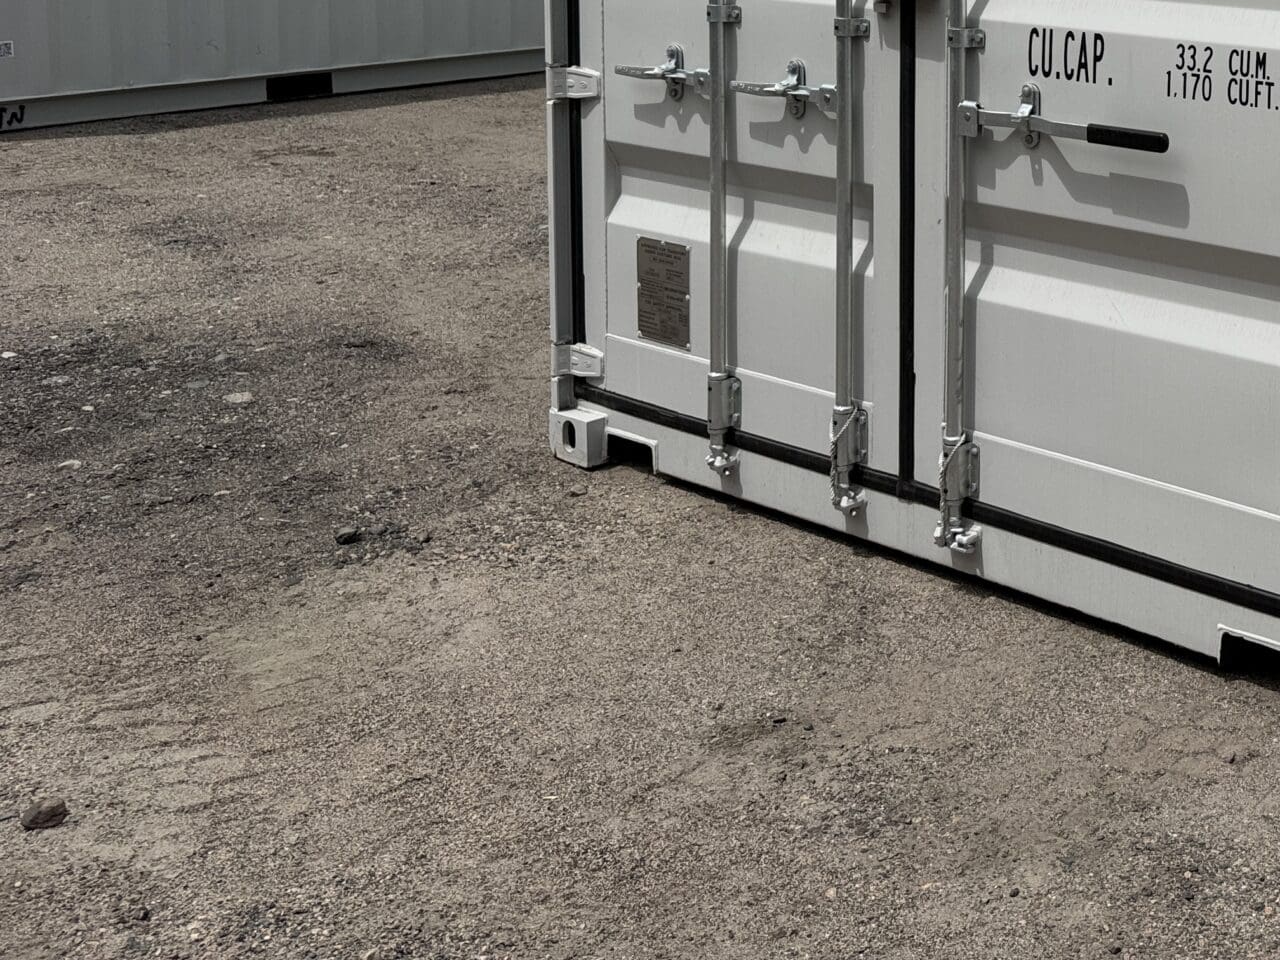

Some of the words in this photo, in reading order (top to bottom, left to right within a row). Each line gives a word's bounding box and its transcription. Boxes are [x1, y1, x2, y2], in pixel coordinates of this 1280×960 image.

[1028, 27, 1113, 86] CU.CAP.
[1175, 43, 1213, 74] 33.2
[1228, 49, 1271, 80] CU.M.
[1166, 70, 1212, 102] 1,170
[1227, 78, 1279, 111] CU.FT.
